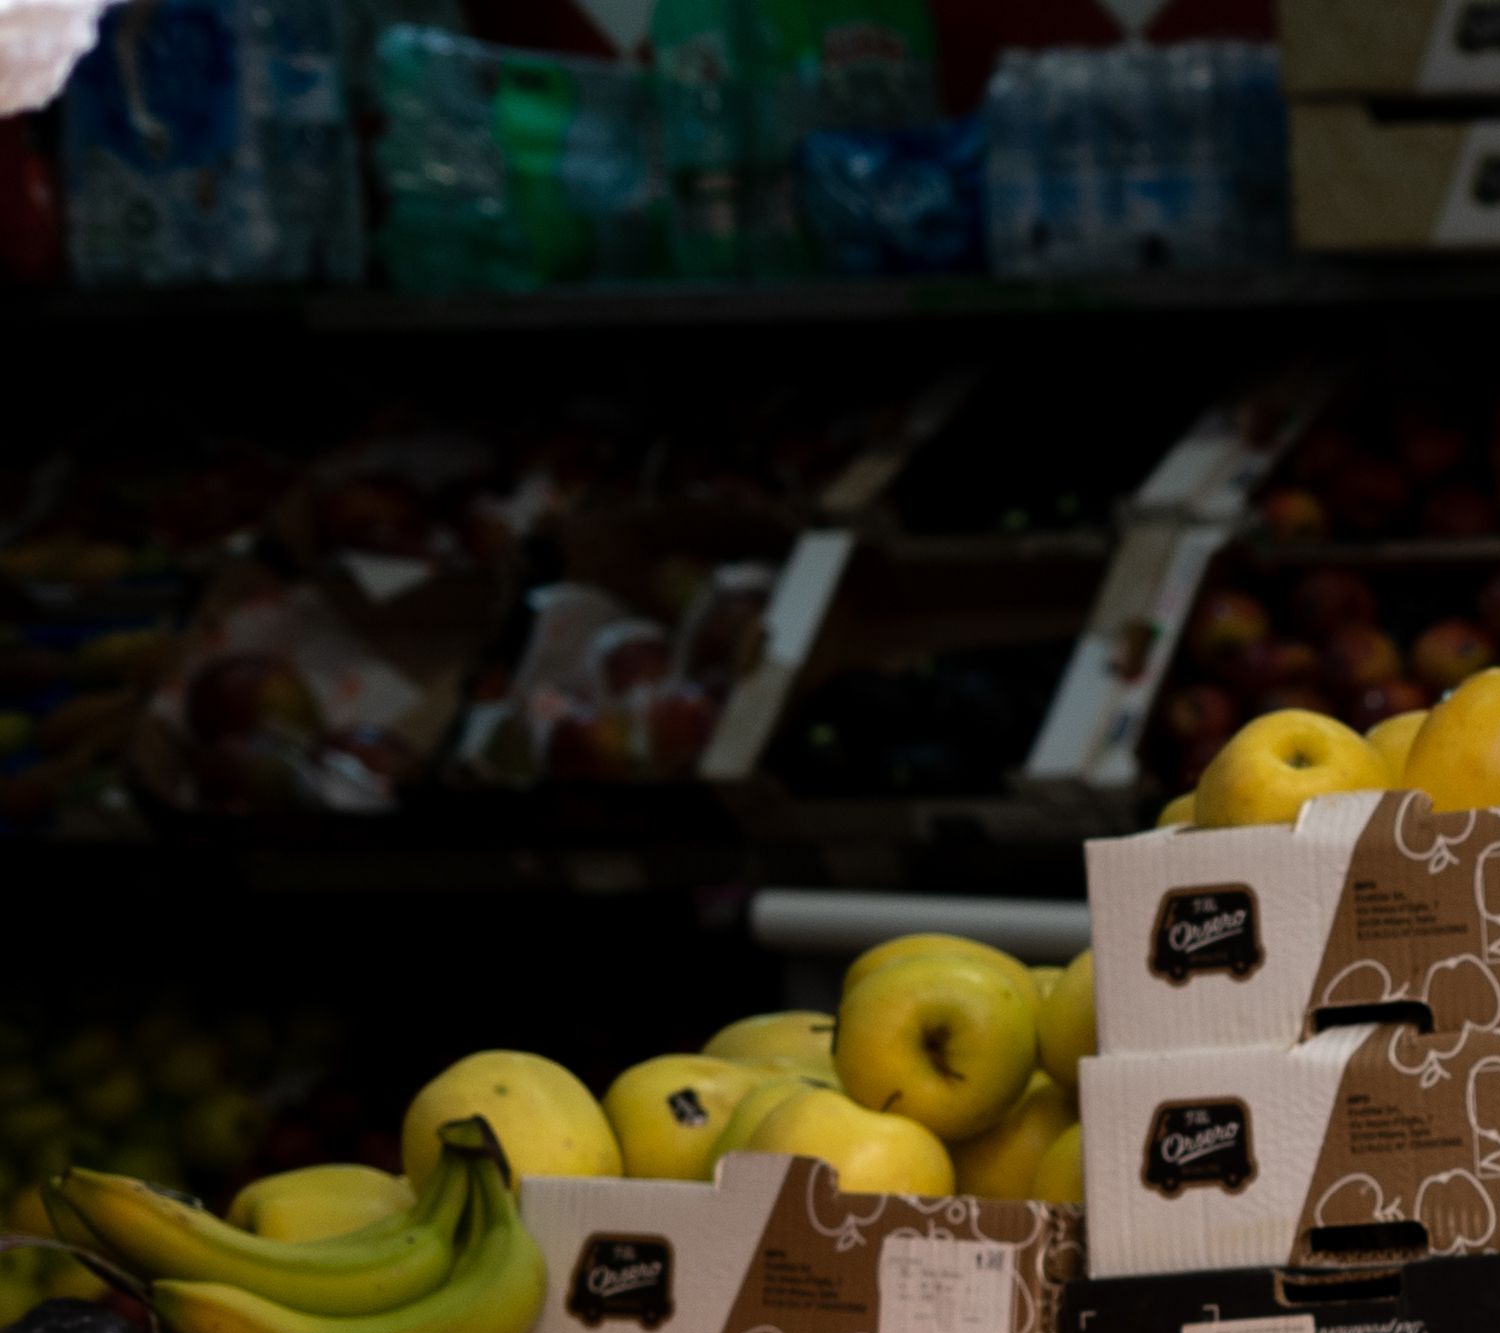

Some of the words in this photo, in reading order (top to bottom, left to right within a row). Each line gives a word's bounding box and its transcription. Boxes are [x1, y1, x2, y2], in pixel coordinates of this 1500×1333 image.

[1170, 909, 1247, 950] Orsero
[1161, 1122, 1239, 1160] Orsero
[588, 1261, 662, 1294] Orsero
